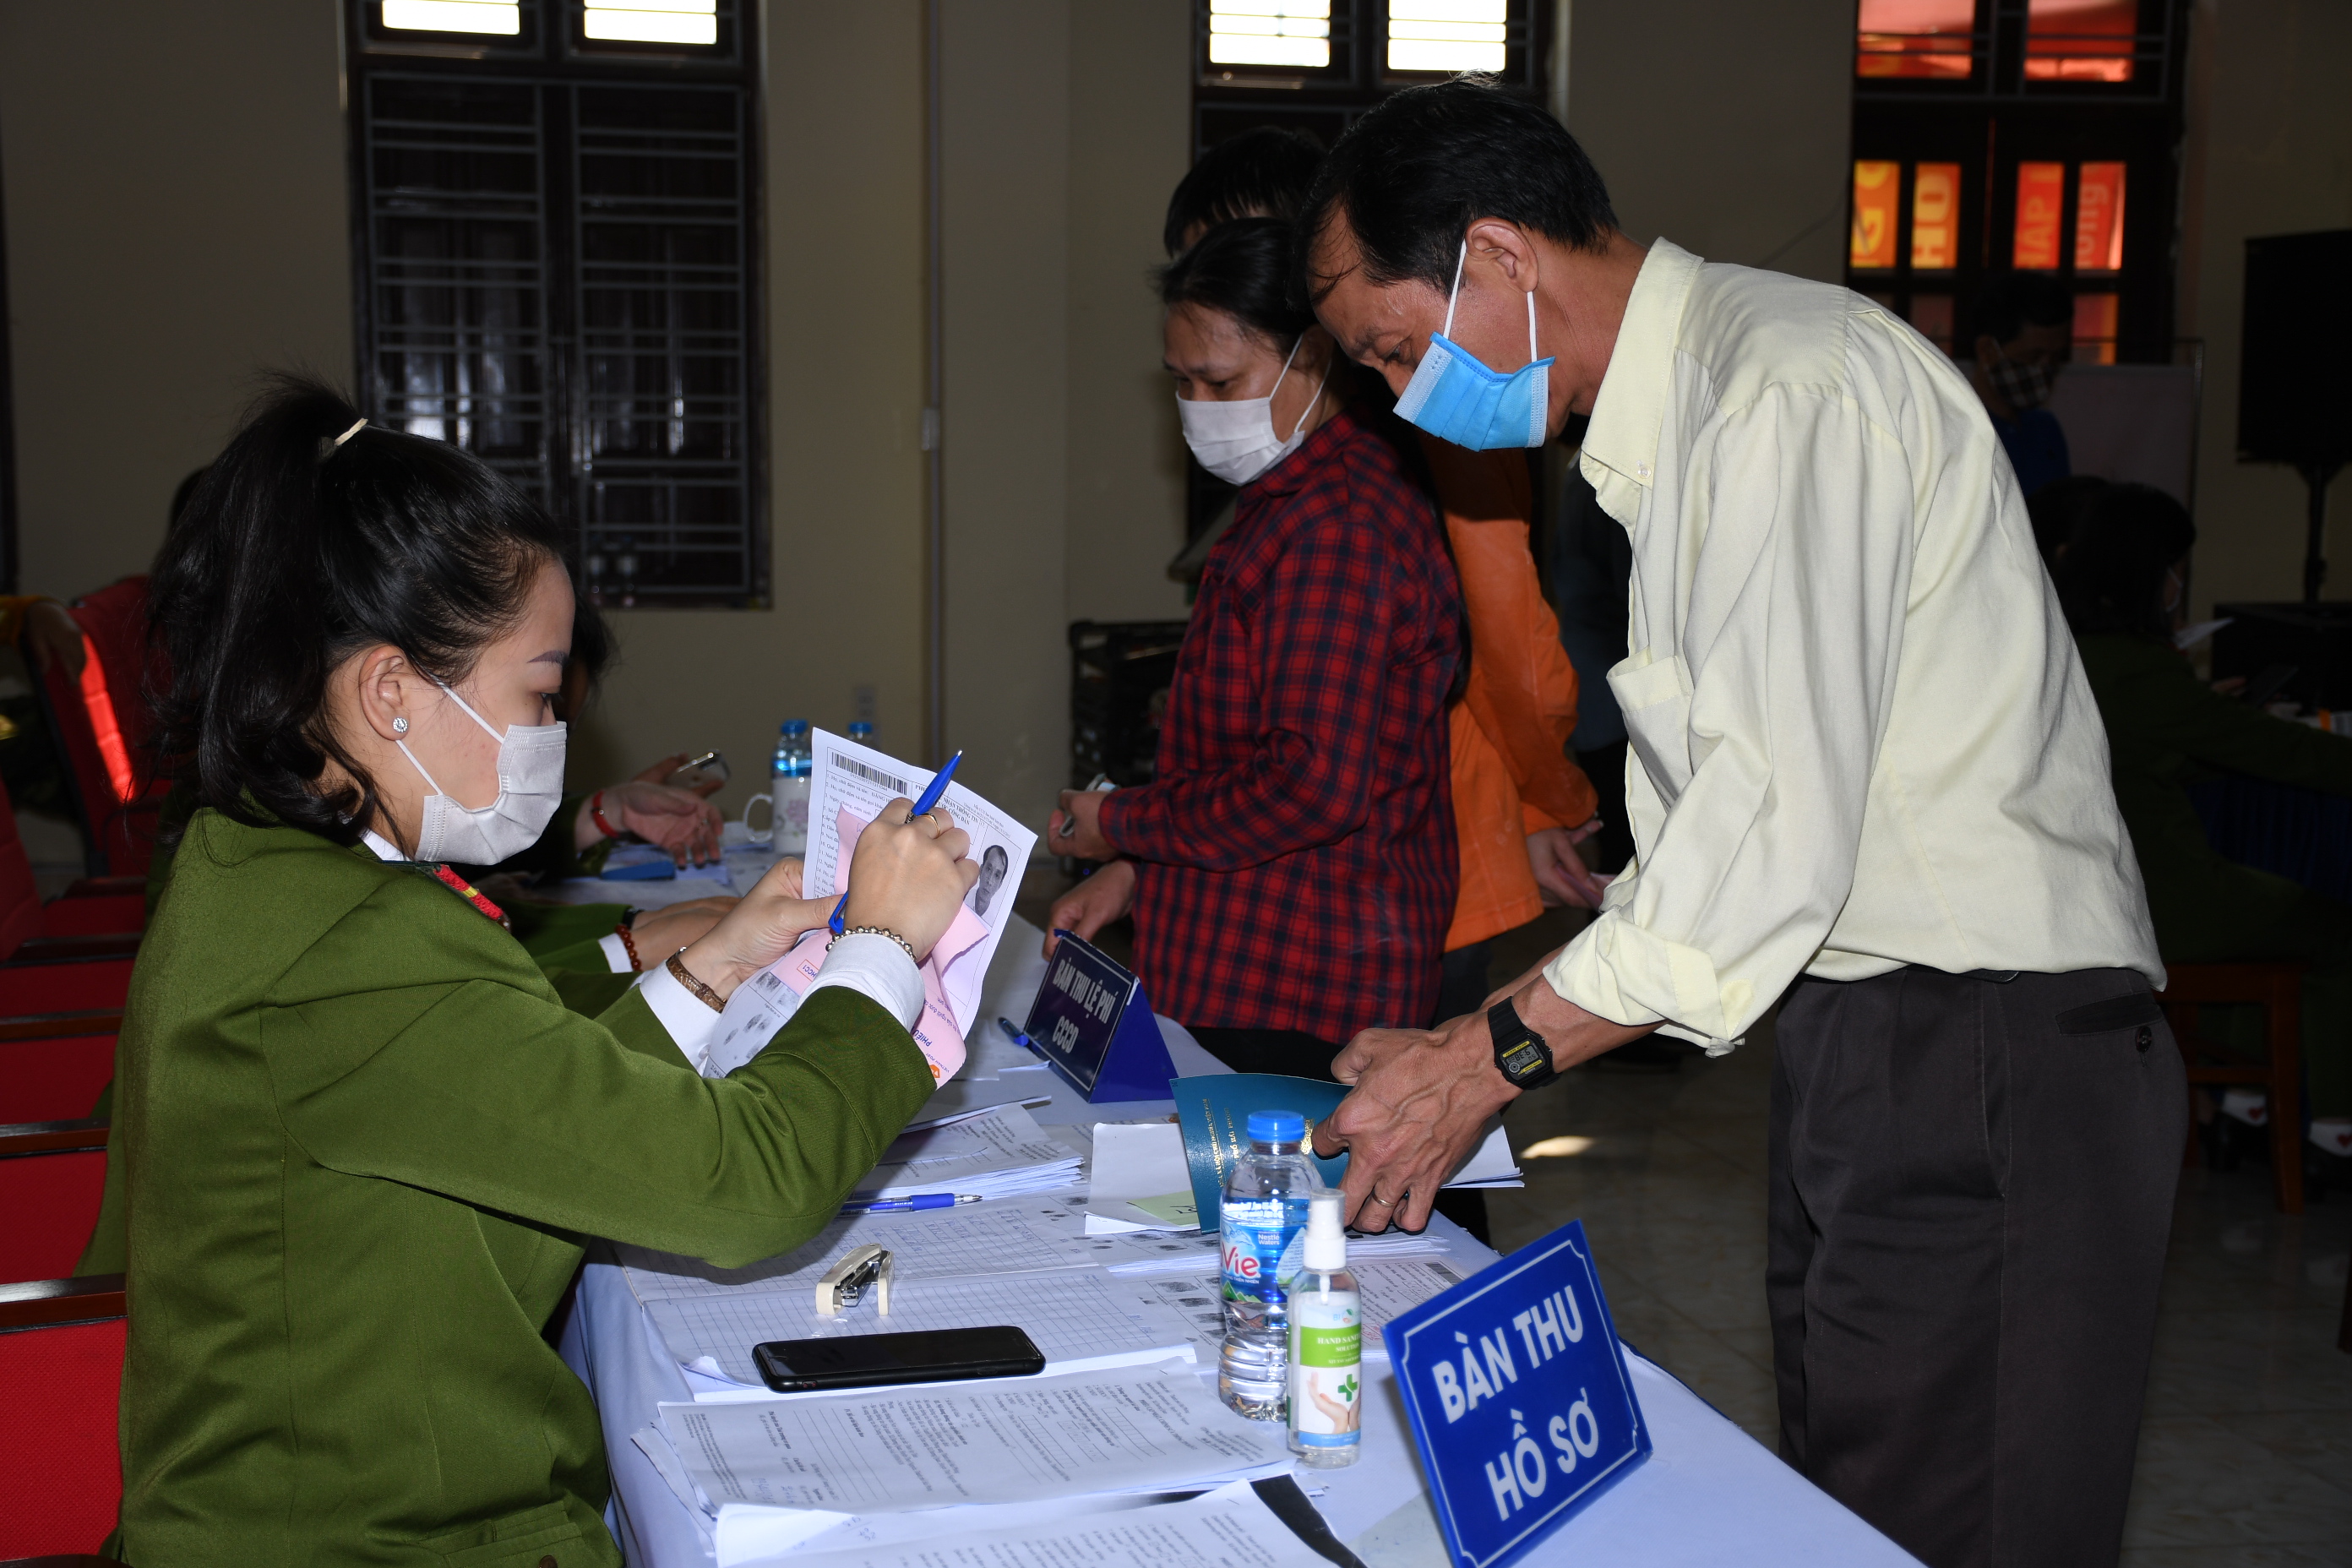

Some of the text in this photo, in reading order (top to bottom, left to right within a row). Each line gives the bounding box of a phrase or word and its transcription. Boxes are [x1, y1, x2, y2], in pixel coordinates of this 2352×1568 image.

[1069, 970, 1092, 1004] THU
[1083, 979, 1103, 1019] LỆ
[1093, 988, 1119, 1025] PHÍ
[1052, 1015, 1080, 1054] CCCD
[1317, 1337, 1342, 1345] HAND
[1432, 1331, 1517, 1424] BÀN
[1512, 1284, 1584, 1369] THU
[1484, 1387, 1600, 1522] HỒ SƠ
